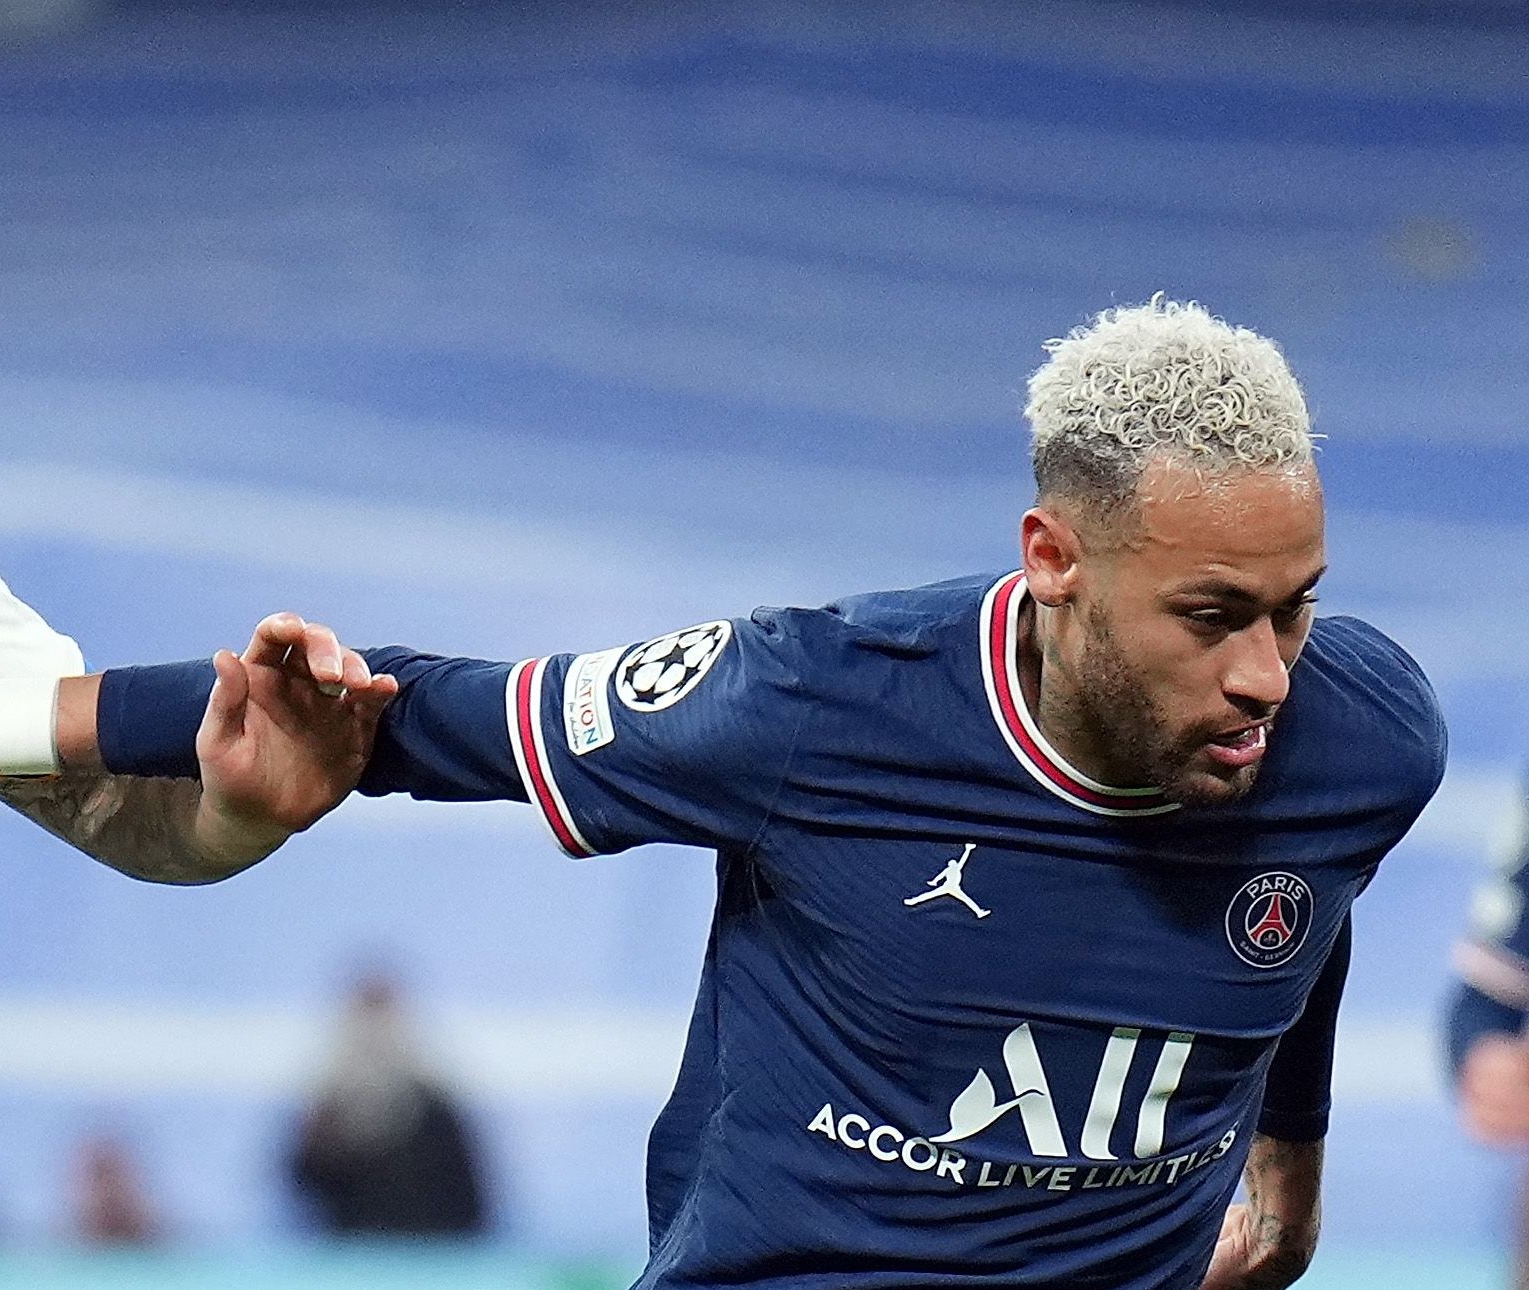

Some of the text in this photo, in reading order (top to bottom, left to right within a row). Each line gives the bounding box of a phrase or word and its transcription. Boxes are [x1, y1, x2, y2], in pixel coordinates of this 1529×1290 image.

[1246, 876, 1305, 901] PARIS
[806, 1102, 967, 1185] ACCOR
[977, 1161, 1077, 1192] LIVE
